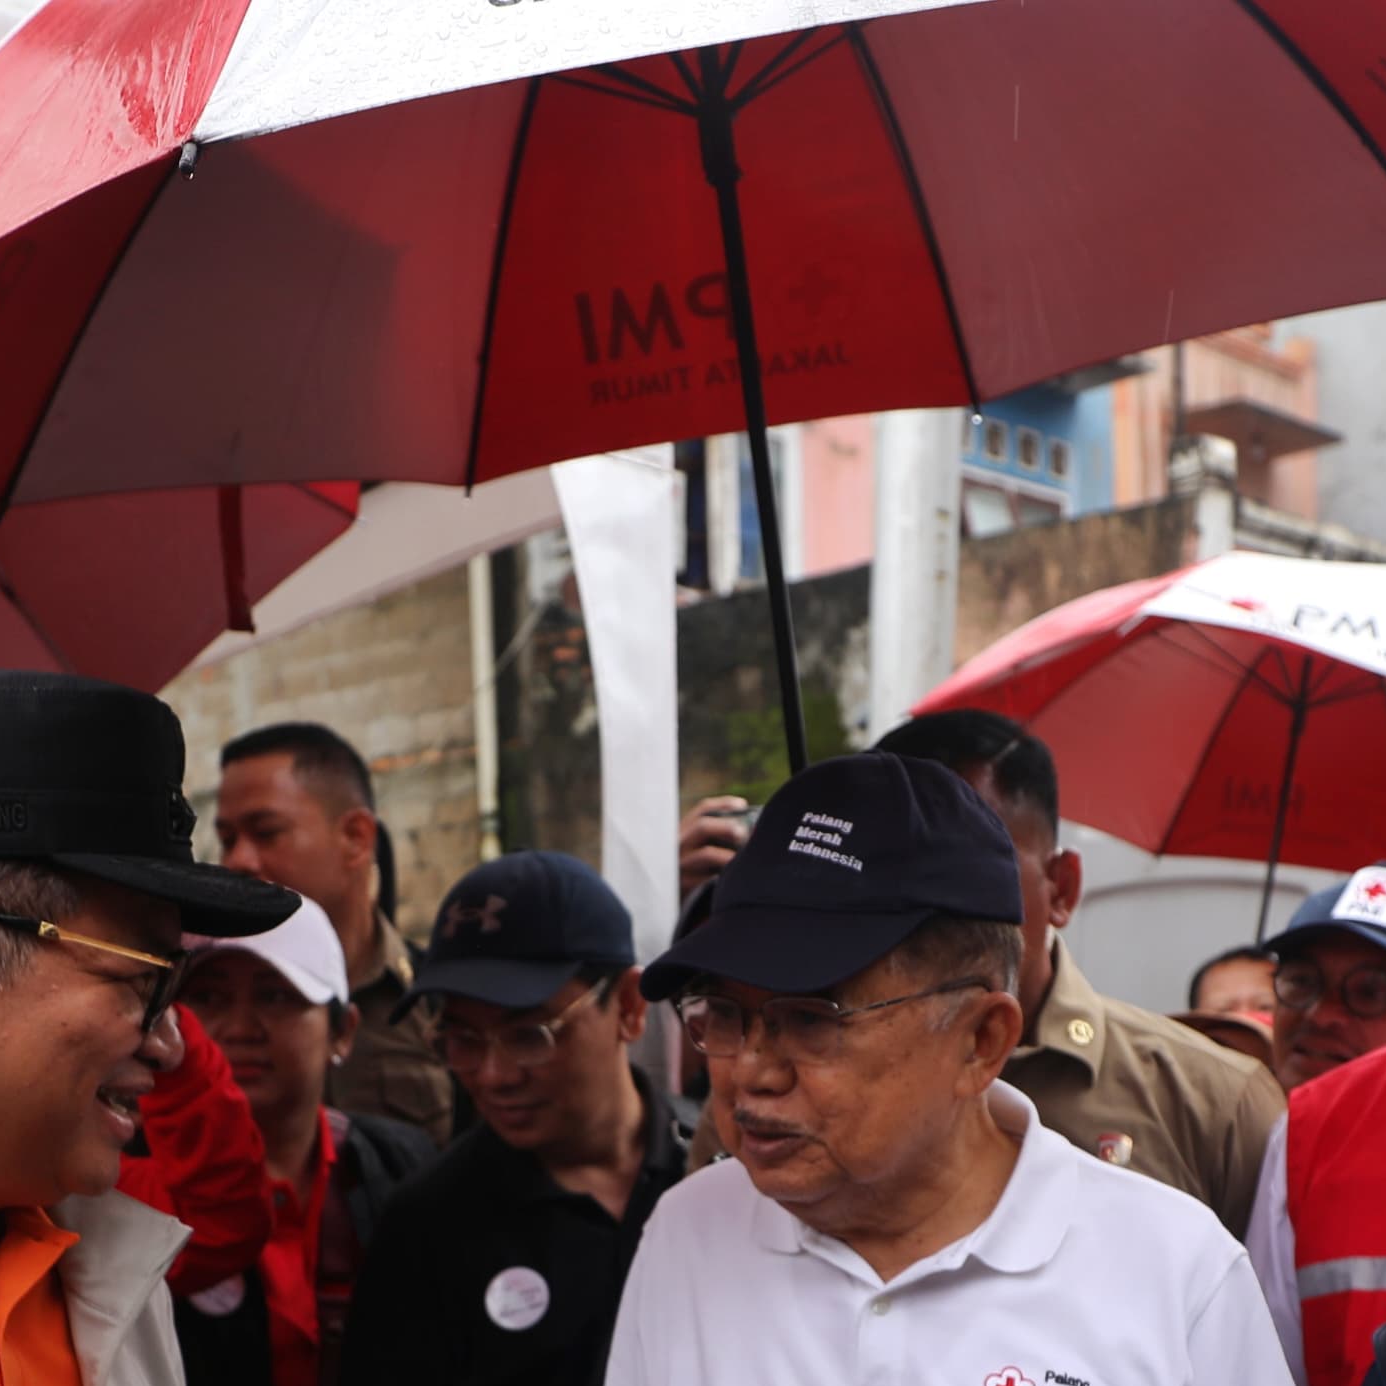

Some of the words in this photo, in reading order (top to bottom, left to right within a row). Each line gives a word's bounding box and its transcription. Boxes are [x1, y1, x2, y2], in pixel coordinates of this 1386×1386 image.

[802, 811, 854, 834] Palang
[795, 825, 843, 846] Merah
[788, 839, 863, 871] Indonesia
